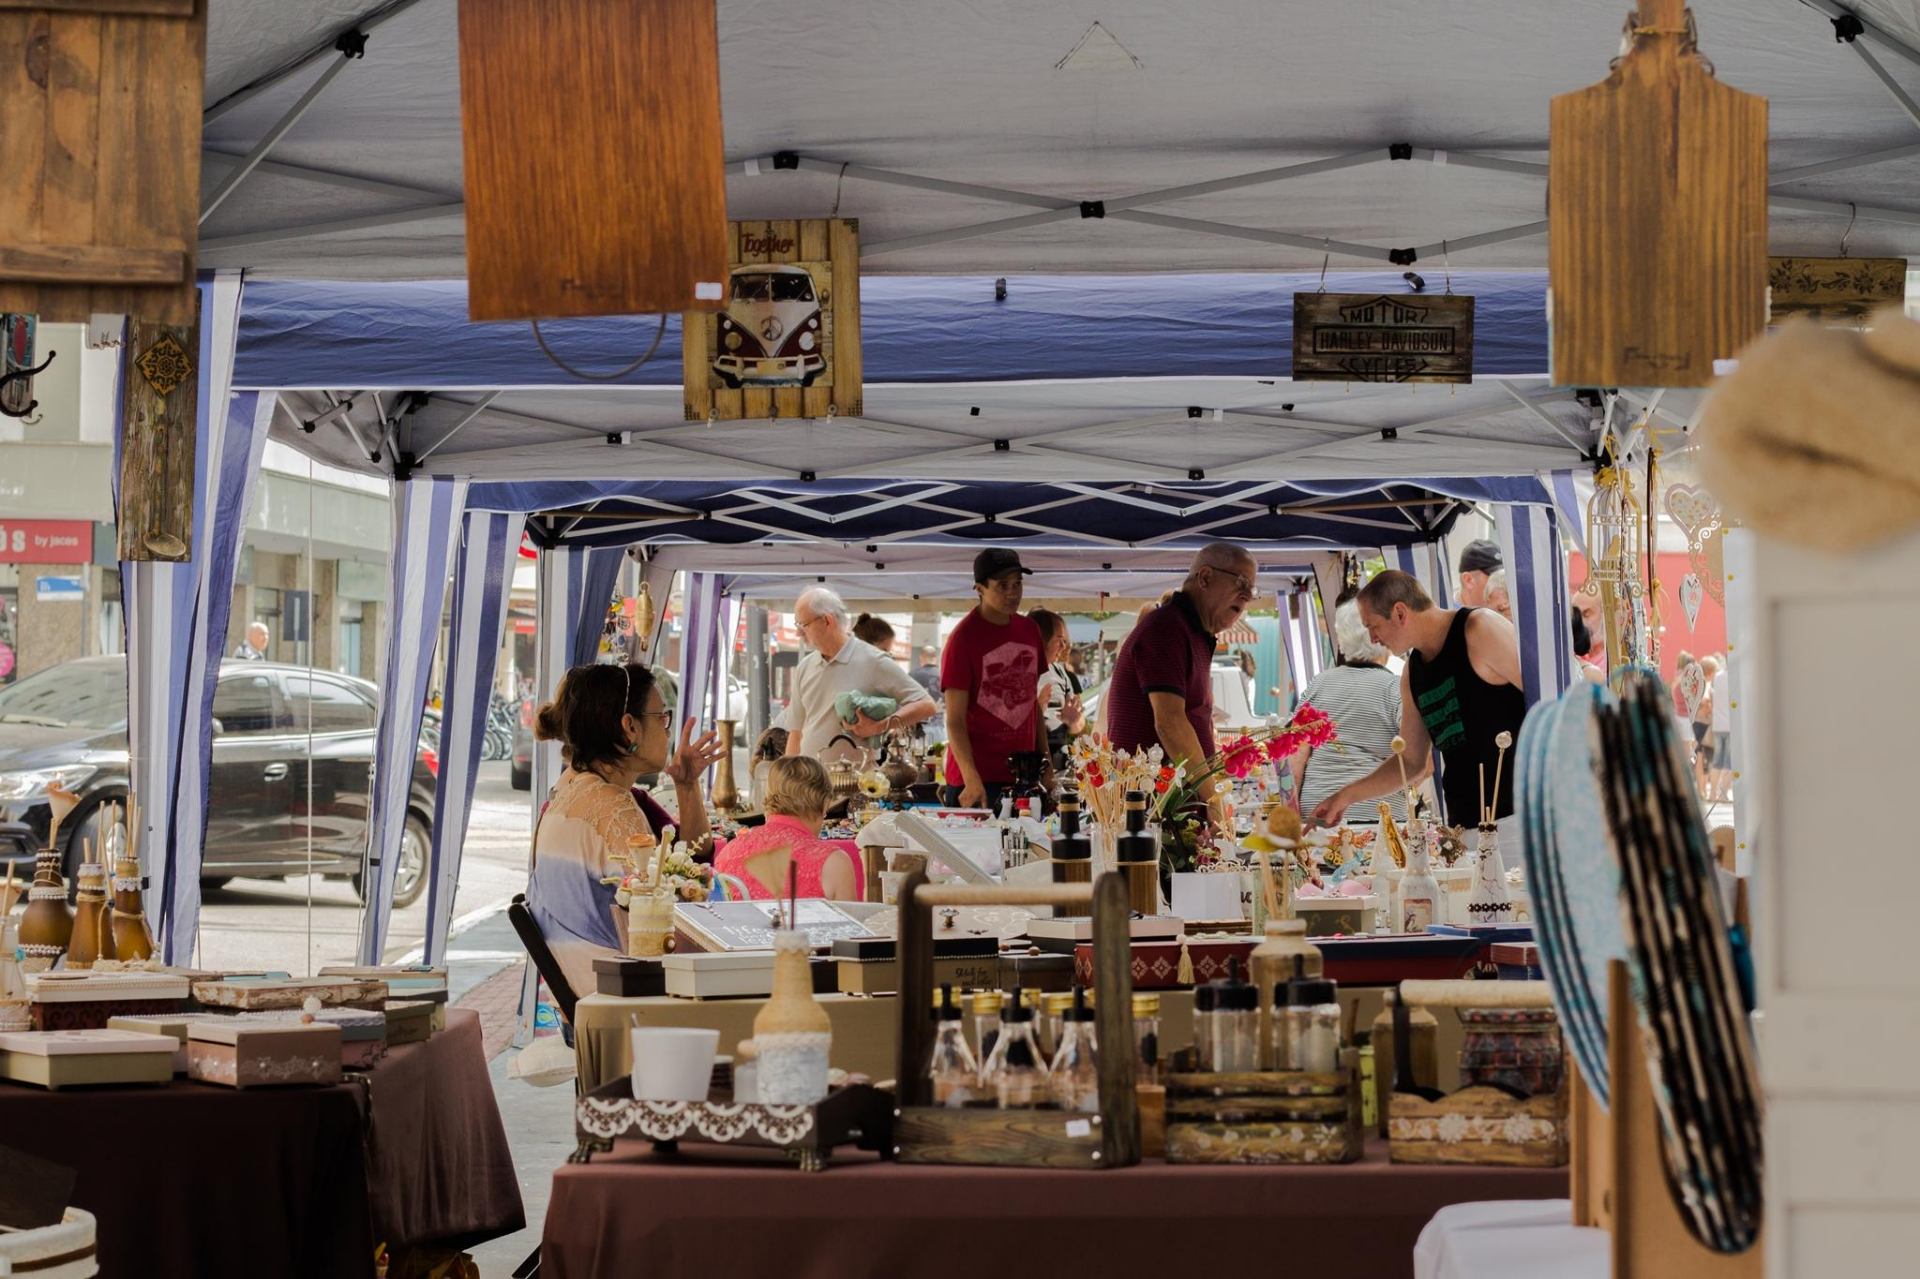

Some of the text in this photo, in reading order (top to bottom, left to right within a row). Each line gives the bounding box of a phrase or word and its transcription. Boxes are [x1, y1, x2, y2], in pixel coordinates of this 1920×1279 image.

[742, 232, 794, 257] Together
[1350, 301, 1418, 323] MOTOR
[1320, 331, 1448, 351] HARLEY DAVIDSON
